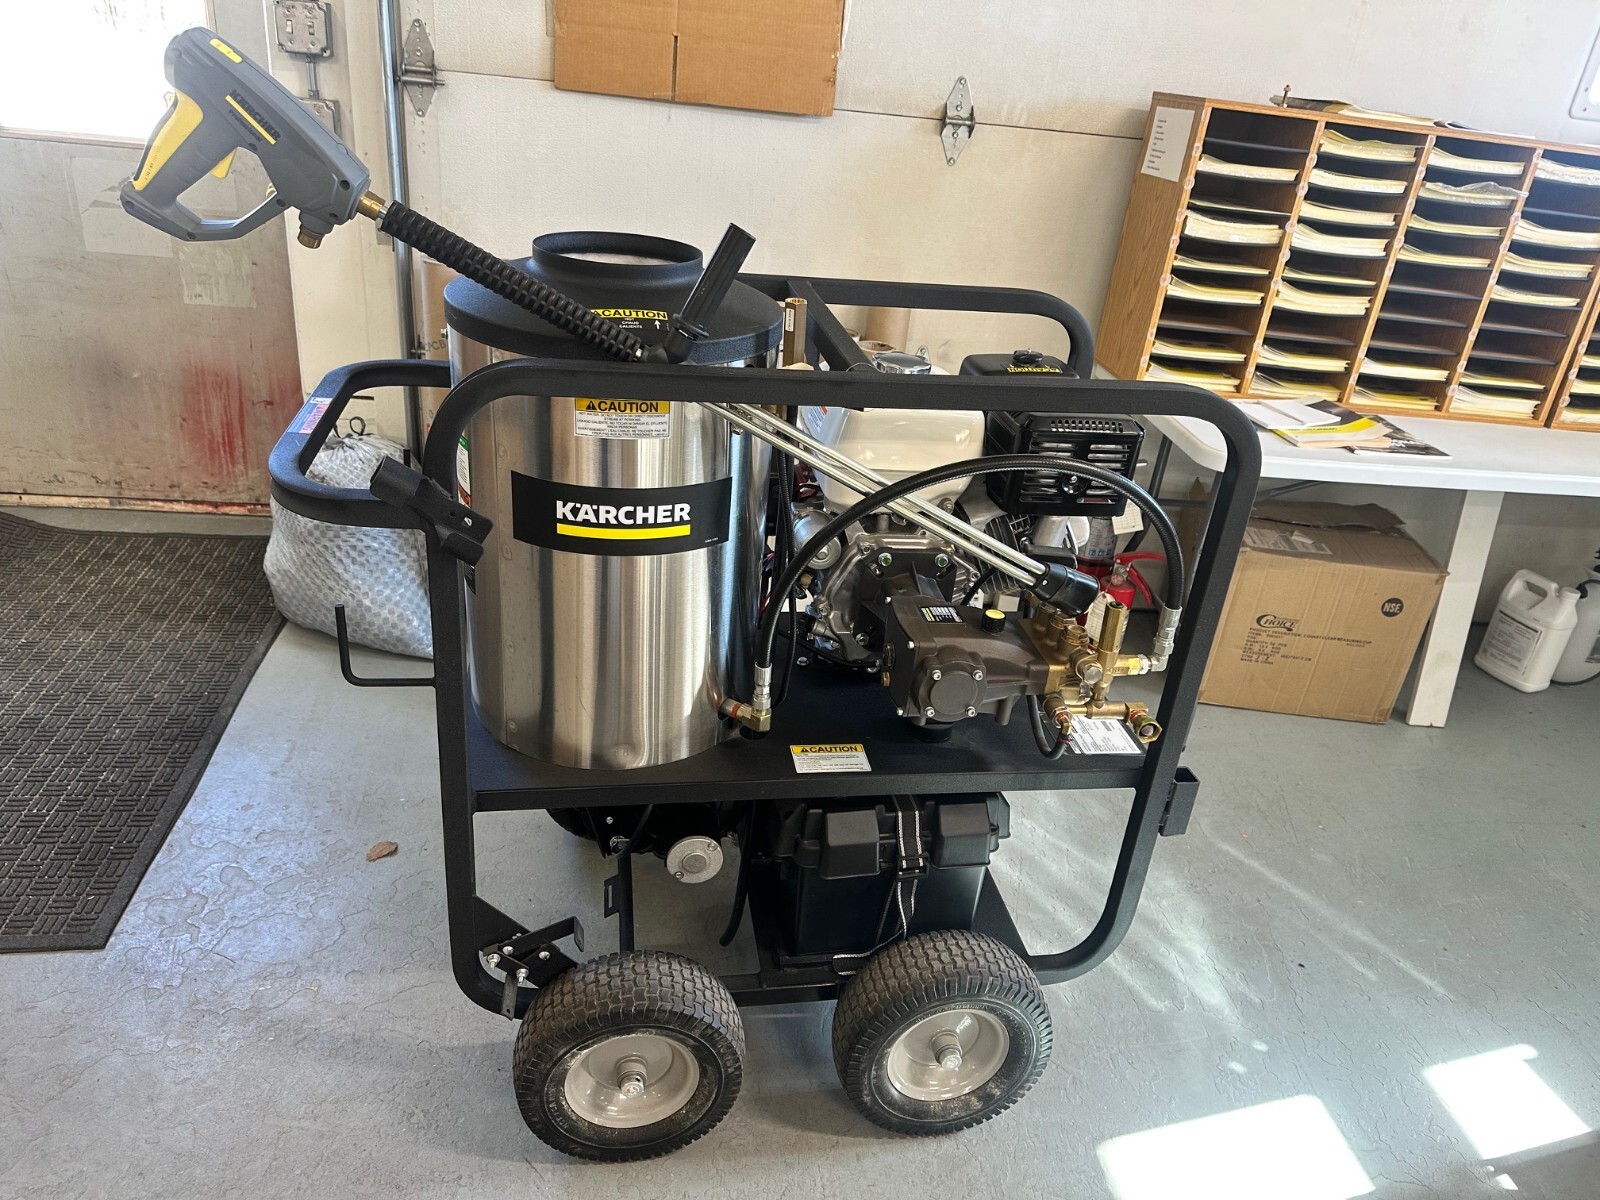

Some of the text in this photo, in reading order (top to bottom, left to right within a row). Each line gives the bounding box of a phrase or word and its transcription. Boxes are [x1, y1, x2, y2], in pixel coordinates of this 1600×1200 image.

[601, 309, 667, 319] CAUTION
[597, 400, 659, 412] CAUTION
[556, 500, 691, 525] KÄRCHER
[809, 745, 858, 753] CAUTION
